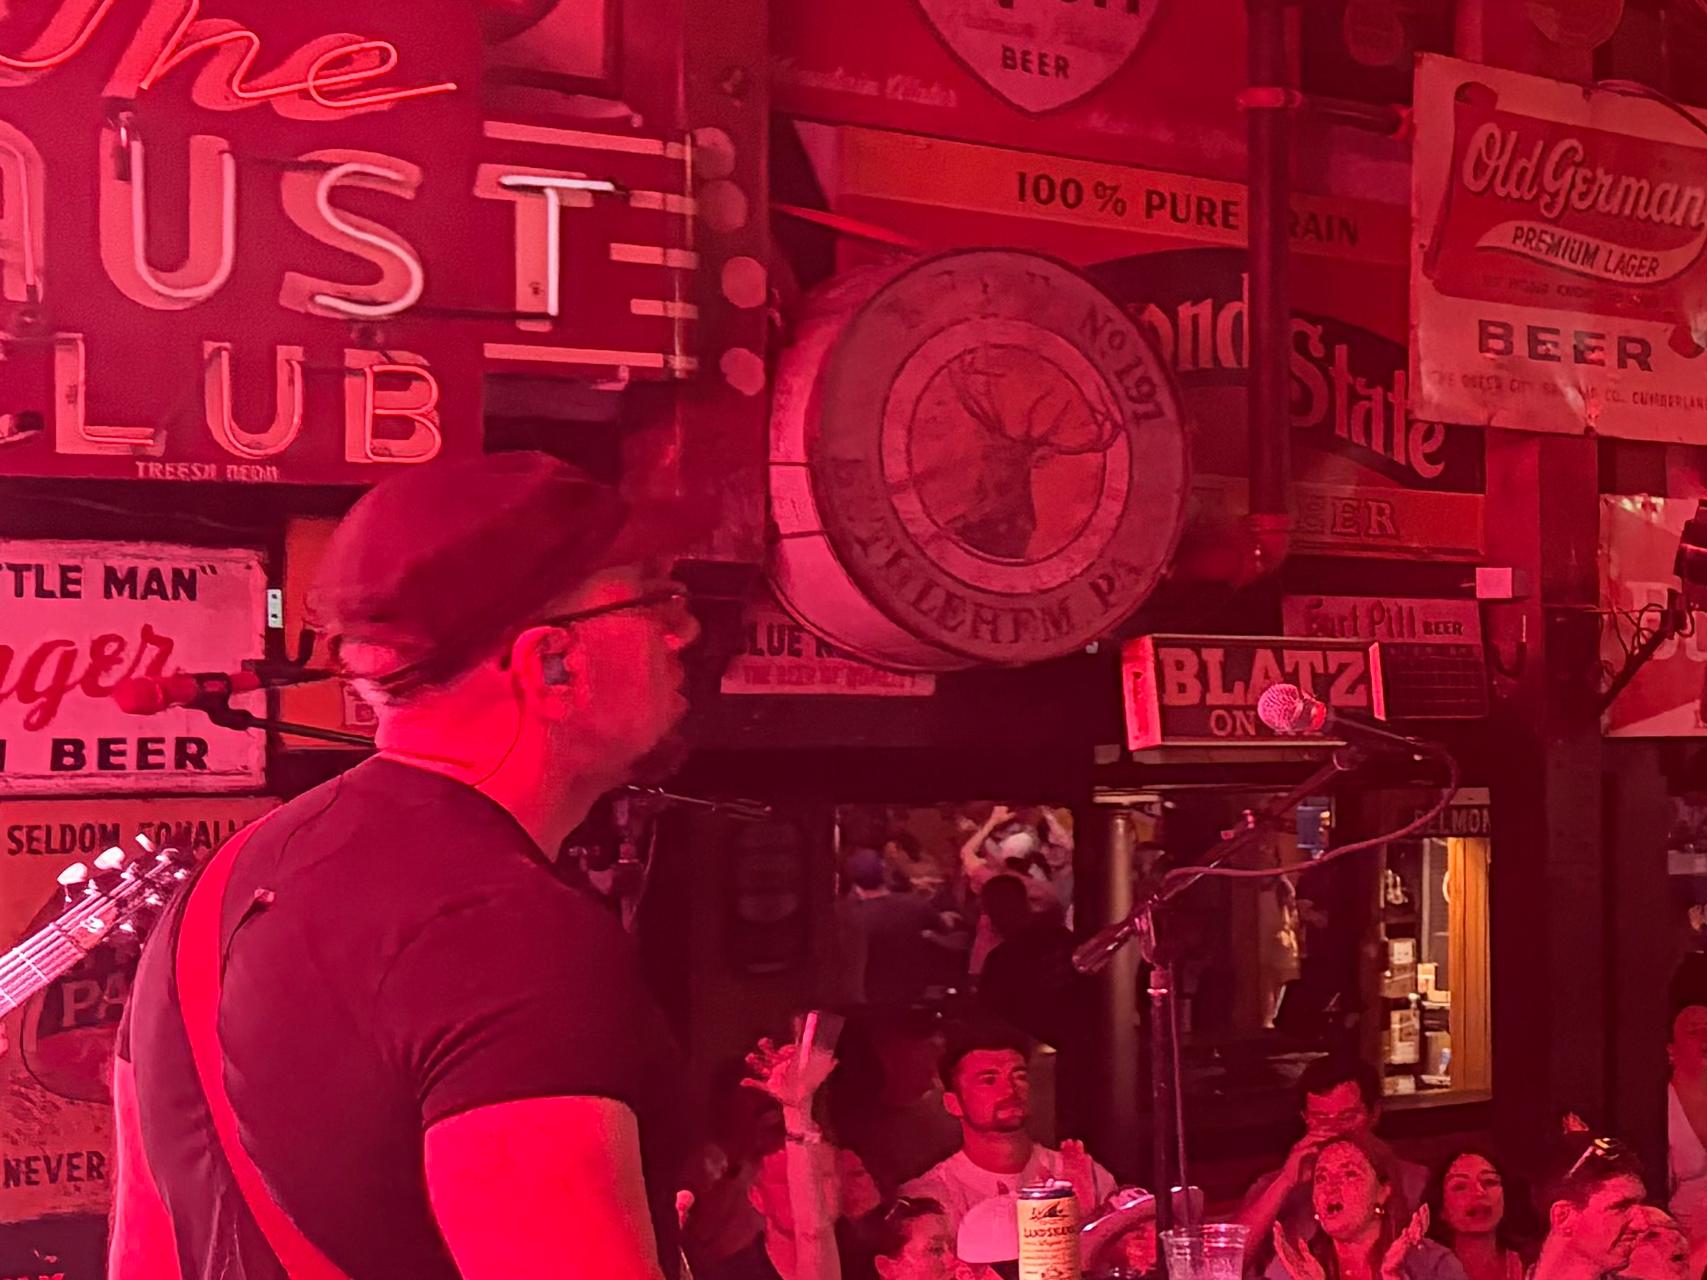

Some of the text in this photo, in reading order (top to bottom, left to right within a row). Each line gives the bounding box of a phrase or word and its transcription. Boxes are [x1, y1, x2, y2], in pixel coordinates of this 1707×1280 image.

[1001, 46, 1071, 79] BEER
[1462, 123, 1707, 230] Old German
[1143, 191, 1241, 231] PURE
[1511, 224, 1660, 279] PREMIUM LAGER
[1478, 318, 1653, 373] BEER
[1290, 319, 1449, 477] State
[0, 564, 82, 600] TLE
[1422, 620, 1463, 637] BEER
[1157, 646, 1369, 708] BLATZ
[1210, 708, 1256, 737] ON
[50, 736, 210, 773] BEER
[8, 824, 119, 855] SELDOM
[4, 1153, 105, 1188] NEVER
